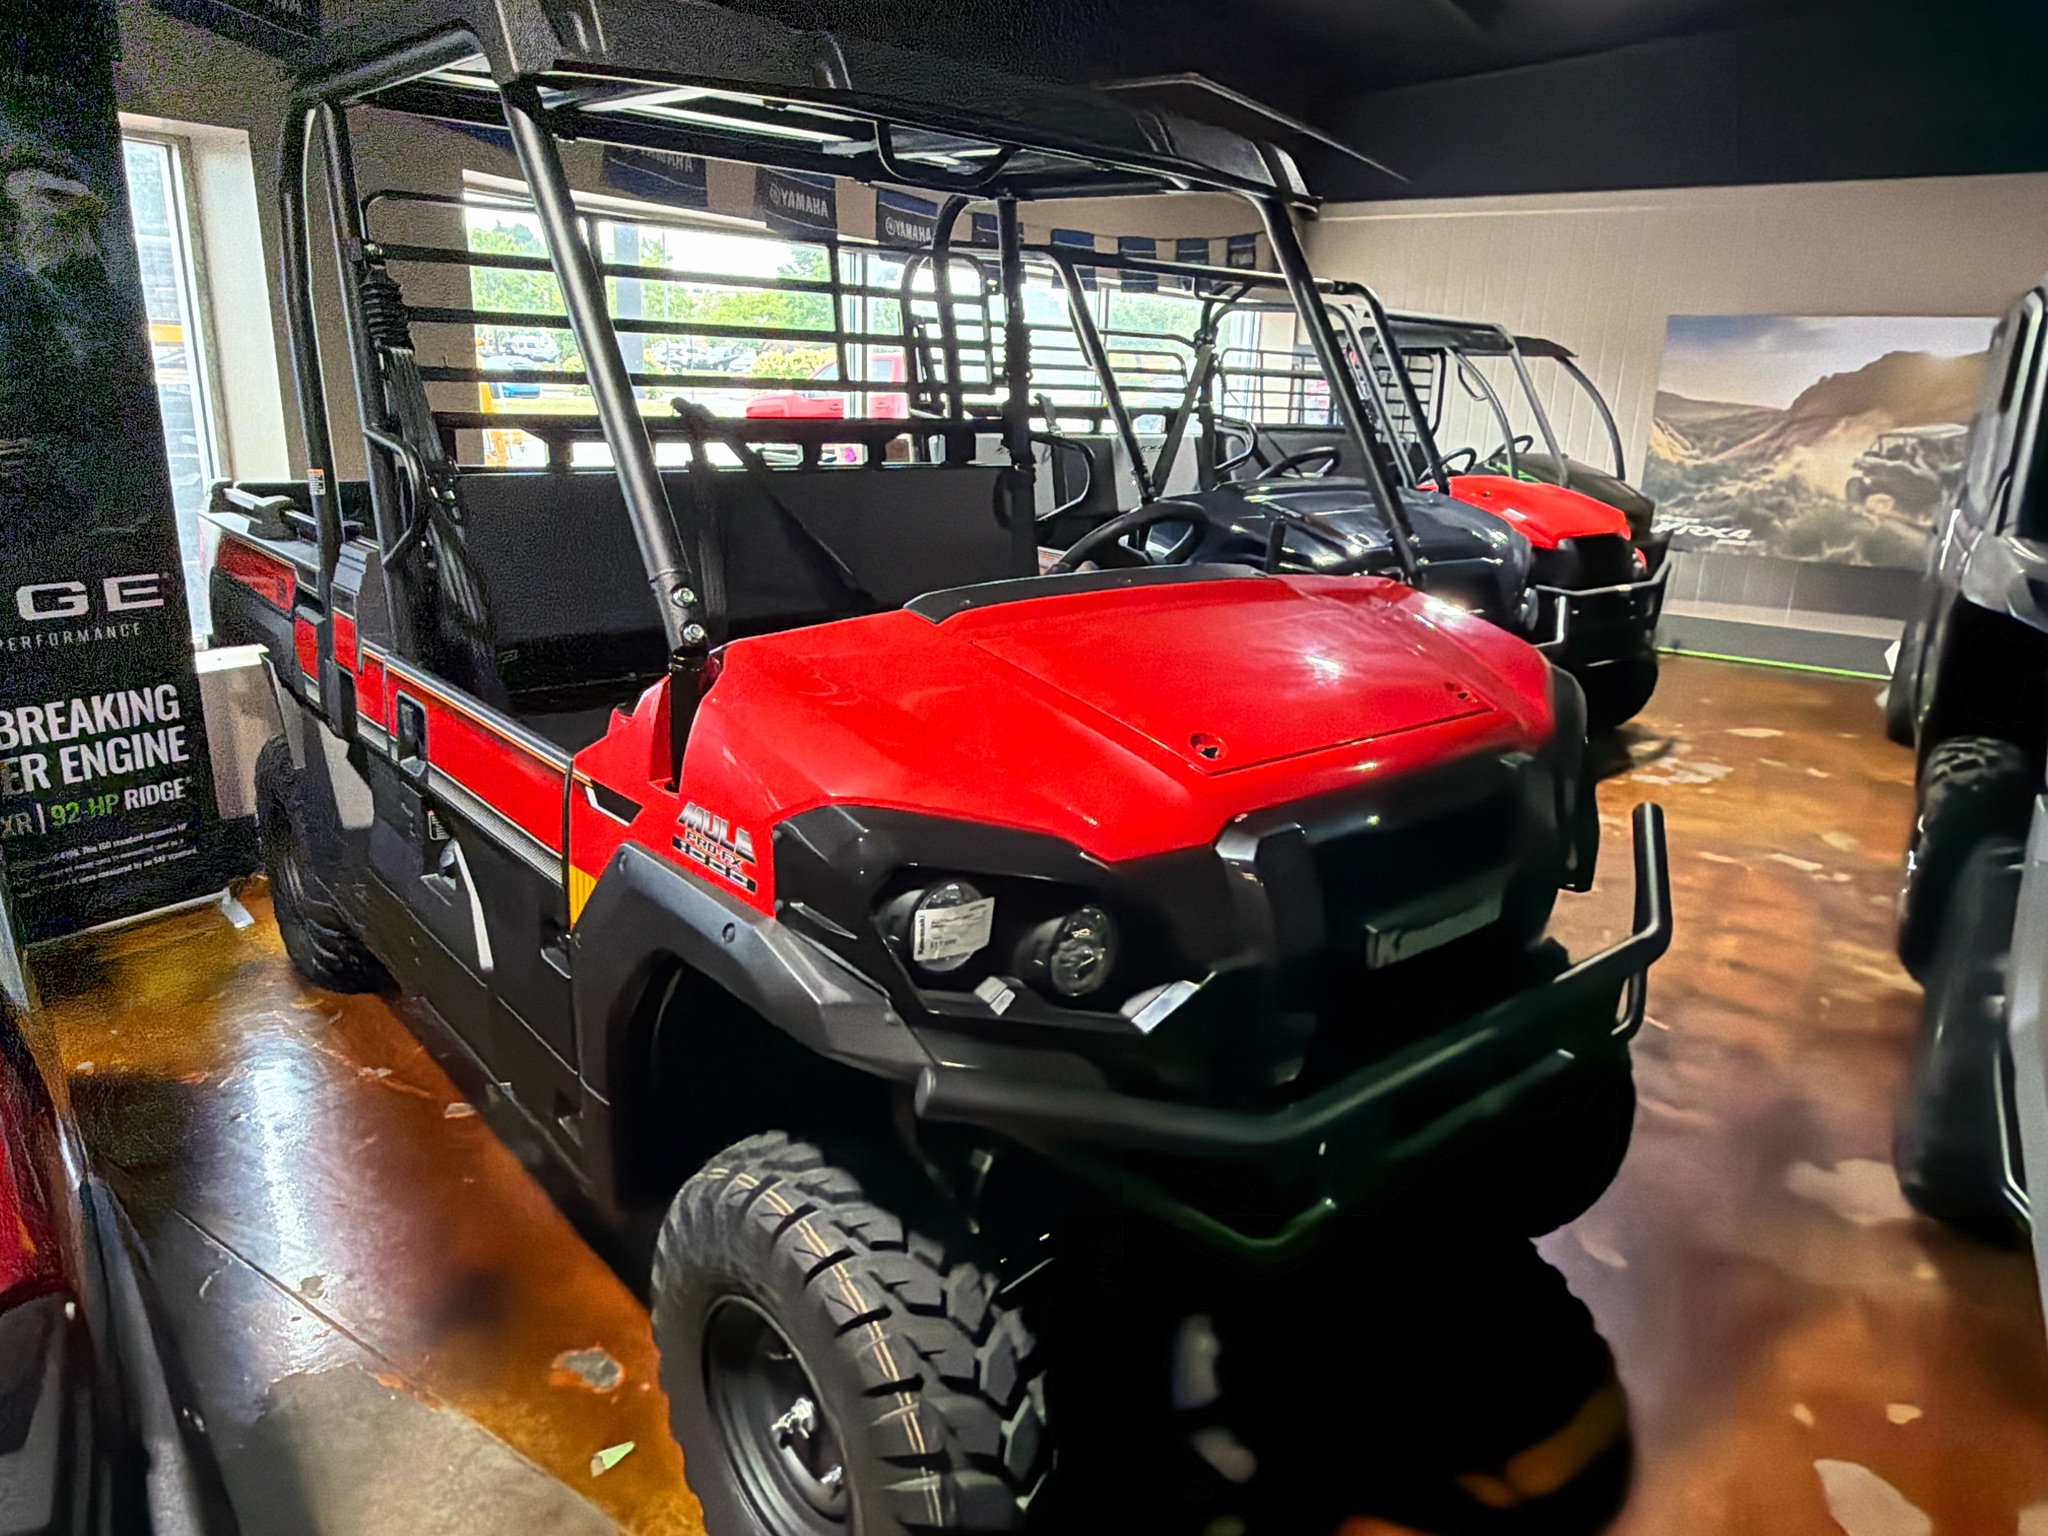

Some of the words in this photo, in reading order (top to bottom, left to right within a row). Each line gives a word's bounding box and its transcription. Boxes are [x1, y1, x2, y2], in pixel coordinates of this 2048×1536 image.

[781, 188, 829, 218] YAMAHA
[895, 220, 932, 242] YAMAHA
[16, 573, 164, 621] GE
[0, 684, 181, 749] BREAKING
[59, 725, 189, 785] ENGINE
[51, 802, 80, 828] 92
[88, 794, 119, 818] HP
[124, 778, 186, 811] RIDGE
[686, 831, 717, 856] PRO
[721, 851, 744, 872] FX
